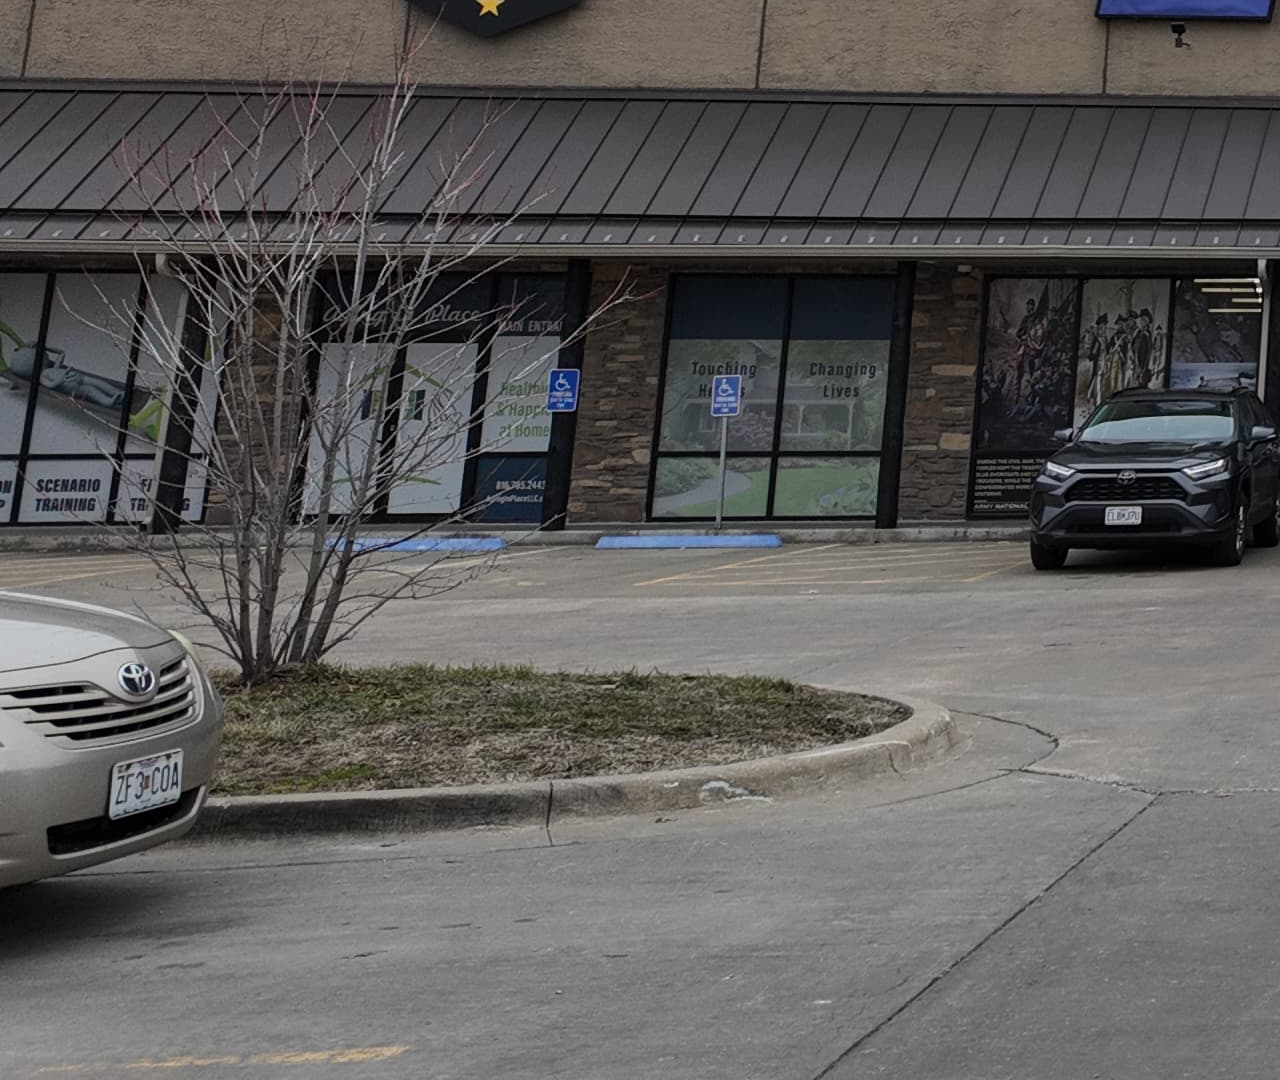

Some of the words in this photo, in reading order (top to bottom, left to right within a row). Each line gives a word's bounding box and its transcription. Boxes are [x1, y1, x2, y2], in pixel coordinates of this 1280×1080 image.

[692, 362, 757, 377] Touching
[809, 362, 876, 378] Changing
[823, 383, 860, 398] Lives
[36, 479, 101, 493] SCENARIO
[35, 498, 96, 512] TRAINING
